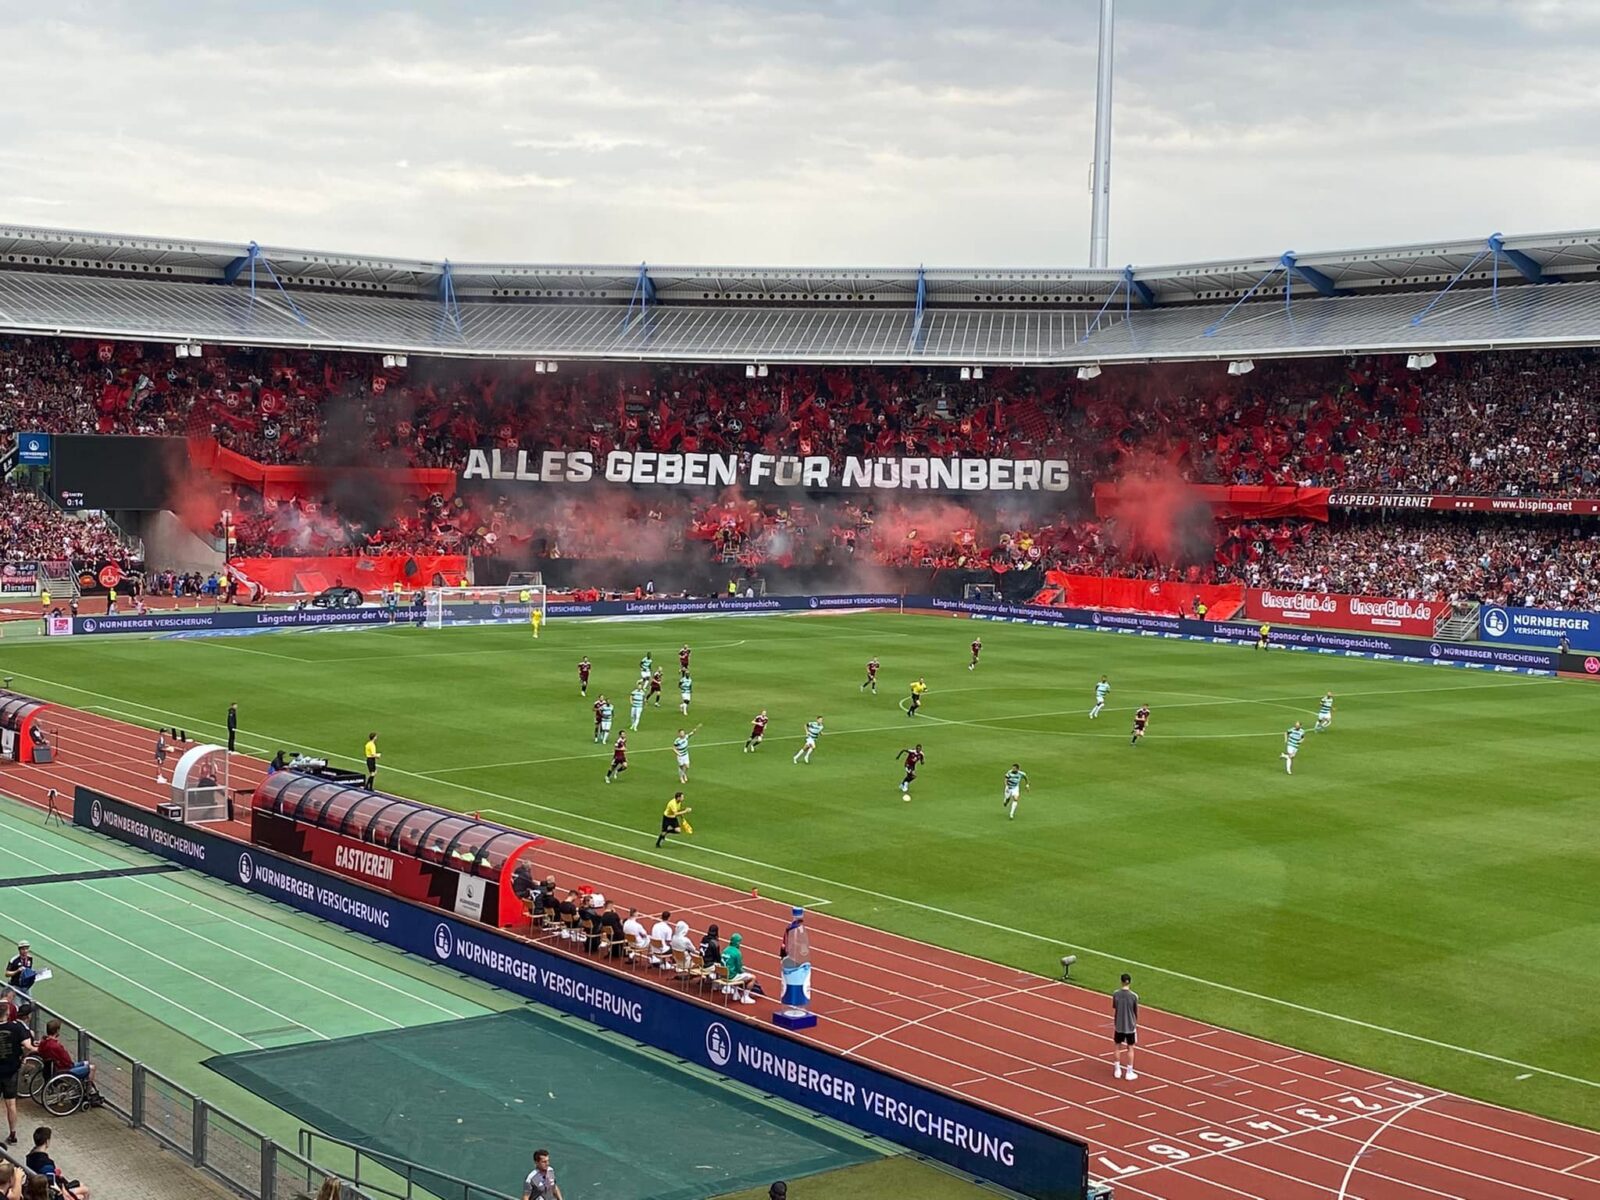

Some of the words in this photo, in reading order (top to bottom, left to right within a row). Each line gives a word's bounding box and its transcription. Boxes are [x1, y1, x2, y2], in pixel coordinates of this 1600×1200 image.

[463, 448, 592, 482] ALLES
[605, 450, 737, 486] GEBEN
[749, 453, 830, 488] FÜR
[842, 456, 1069, 491] NÜRNBERG
[1492, 499, 1573, 512] www.bisping.net
[547, 605, 592, 613] VERSICHERUNG
[626, 603, 657, 612] Längster
[658, 602, 706, 611] Hauptsponsor
[720, 600, 781, 609] Vereinsgeschichte.
[933, 598, 957, 608] Längster
[958, 601, 997, 611] Hauptsponsor
[998, 605, 1008, 613] der
[1009, 606, 1064, 618] Vereinsgeschichte.
[1262, 592, 1337, 612] UnserClub.de
[1350, 597, 1431, 620] UnserClub.de
[99, 620, 153, 629] NÜRNBERGER
[155, 617, 213, 627] VERSICHERUNG
[257, 613, 297, 625] Längster
[299, 611, 361, 623] Hauptsponsor
[362, 610, 375, 619] der
[1103, 616, 1137, 625] NÜRNBERGER
[1139, 619, 1179, 628] VERSICHERUNG
[1513, 615, 1589, 630] NÜRNBERGER
[1214, 625, 1246, 637] Längster
[1302, 633, 1315, 642] der
[1316, 634, 1391, 650] Vereinsgeschichte.
[1443, 647, 1492, 659] NÜRNBERGER
[1493, 652, 1550, 665] VERSICHERUNG
[103, 809, 149, 839] NÜRNBERGER
[150, 827, 205, 860] VERSICHERUNG
[335, 845, 394, 880] GASTVEREIN
[255, 865, 314, 901] NÜRNBERGER
[316, 887, 389, 928] VERSICHERUNG
[456, 938, 537, 984] NÜRNBERGER
[540, 968, 642, 1023] VERSICHERUNG
[1386, 1086, 1424, 1099] 1
[738, 1041, 855, 1105] NÜRNBERGER
[861, 1087, 1014, 1167] VERSICHERUNG
[1338, 1096, 1382, 1110] 2
[1297, 1108, 1337, 1122] 3
[1246, 1120, 1289, 1134] 4
[1199, 1131, 1244, 1148] 5
[1147, 1143, 1190, 1159] 6
[1098, 1157, 1140, 1174] 7
